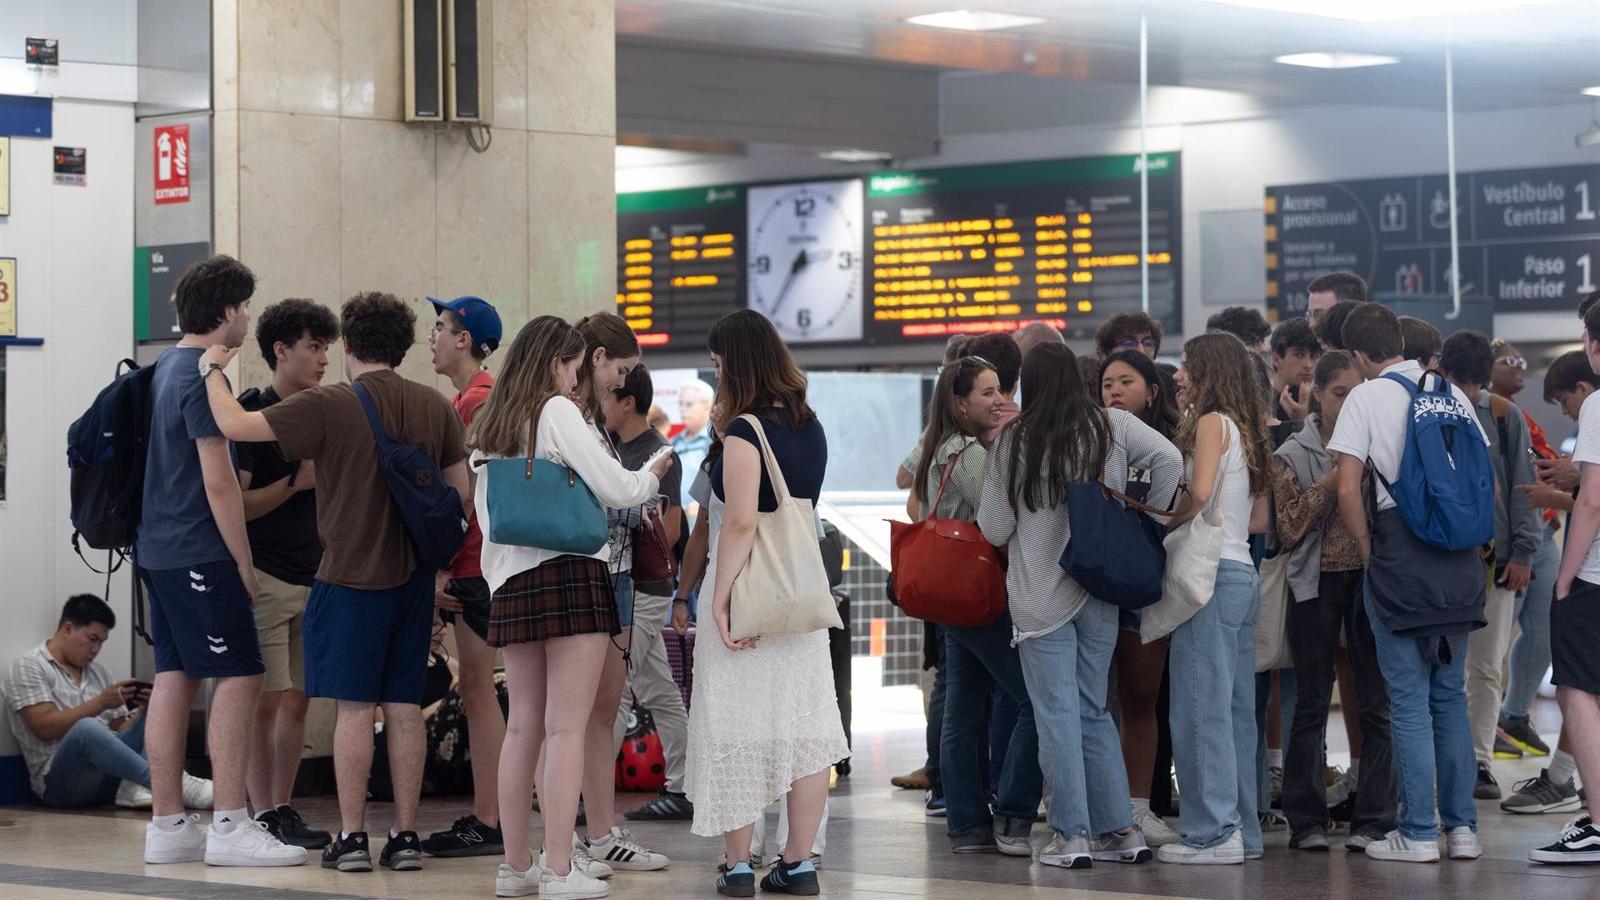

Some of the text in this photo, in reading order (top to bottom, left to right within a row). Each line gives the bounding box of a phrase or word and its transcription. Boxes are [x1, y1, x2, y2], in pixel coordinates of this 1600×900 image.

[1282, 193, 1328, 211] Acceso
[1482, 180, 1566, 205] Vestíbulo
[794, 197, 816, 217] 12
[1503, 203, 1566, 228] Central
[1282, 207, 1359, 231] provisional
[1524, 254, 1566, 276] Paso
[1499, 277, 1566, 300] Inferior
[797, 308, 811, 328] 6
